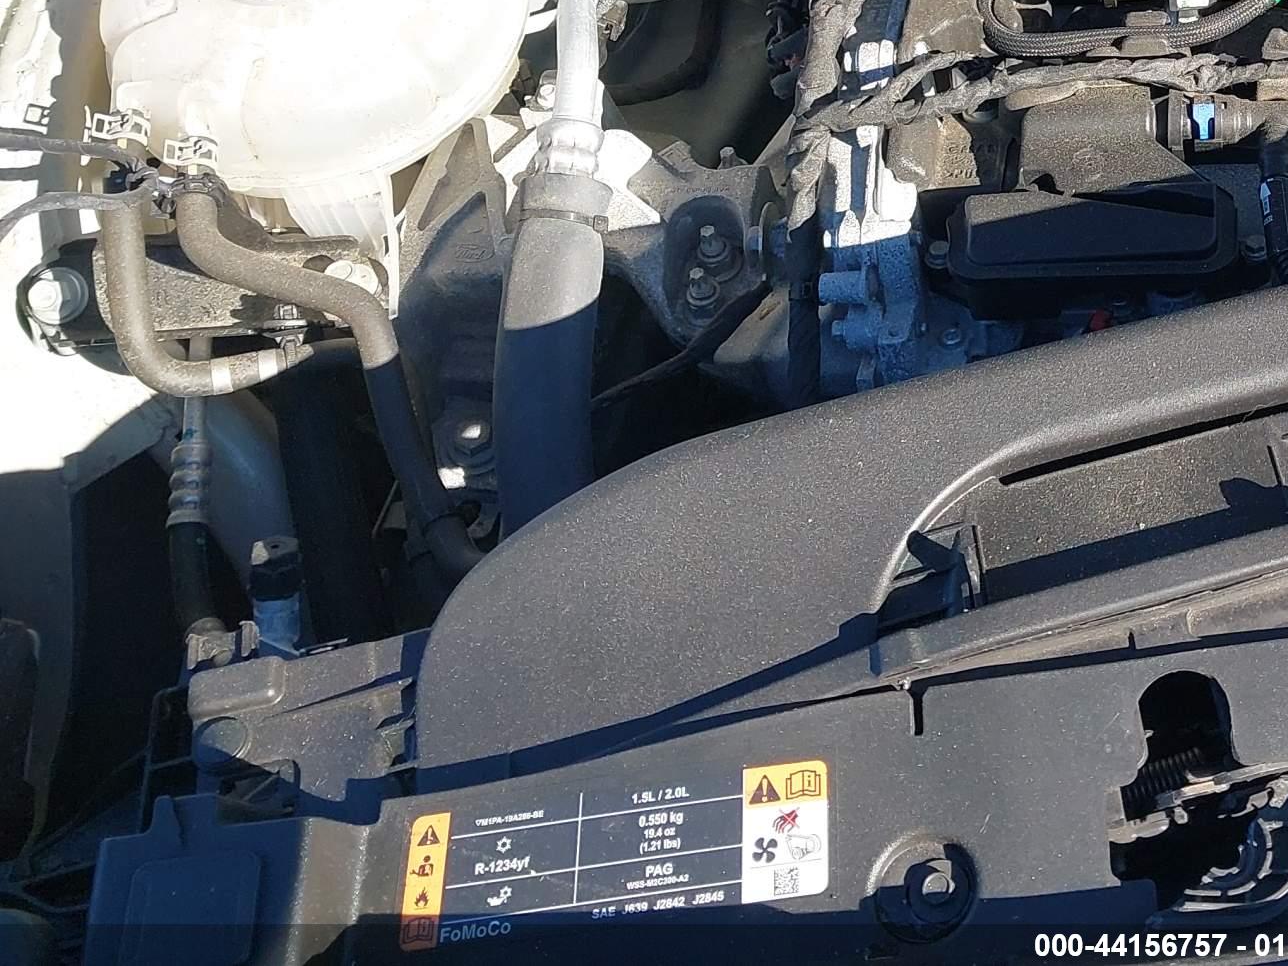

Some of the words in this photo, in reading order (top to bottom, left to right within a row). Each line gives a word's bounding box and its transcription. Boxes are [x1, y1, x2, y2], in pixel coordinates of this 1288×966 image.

[632, 791, 656, 804] 1.5L
[657, 789, 662, 801] /
[664, 786, 690, 800] 2.0L
[638, 813, 668, 828] 0.550
[669, 811, 684, 825] kg
[643, 828, 663, 839] 19.4
[663, 826, 676, 837] oz
[639, 841, 661, 855] (1.21
[663, 837, 681, 850] lbs)
[475, 856, 531, 875] R-1234yf
[645, 862, 674, 878] PAG
[591, 906, 616, 920] SAE
[622, 902, 648, 915] J639
[653, 896, 685, 911] J2842
[692, 890, 725, 905] J2845
[439, 920, 512, 943] FoMoCo
